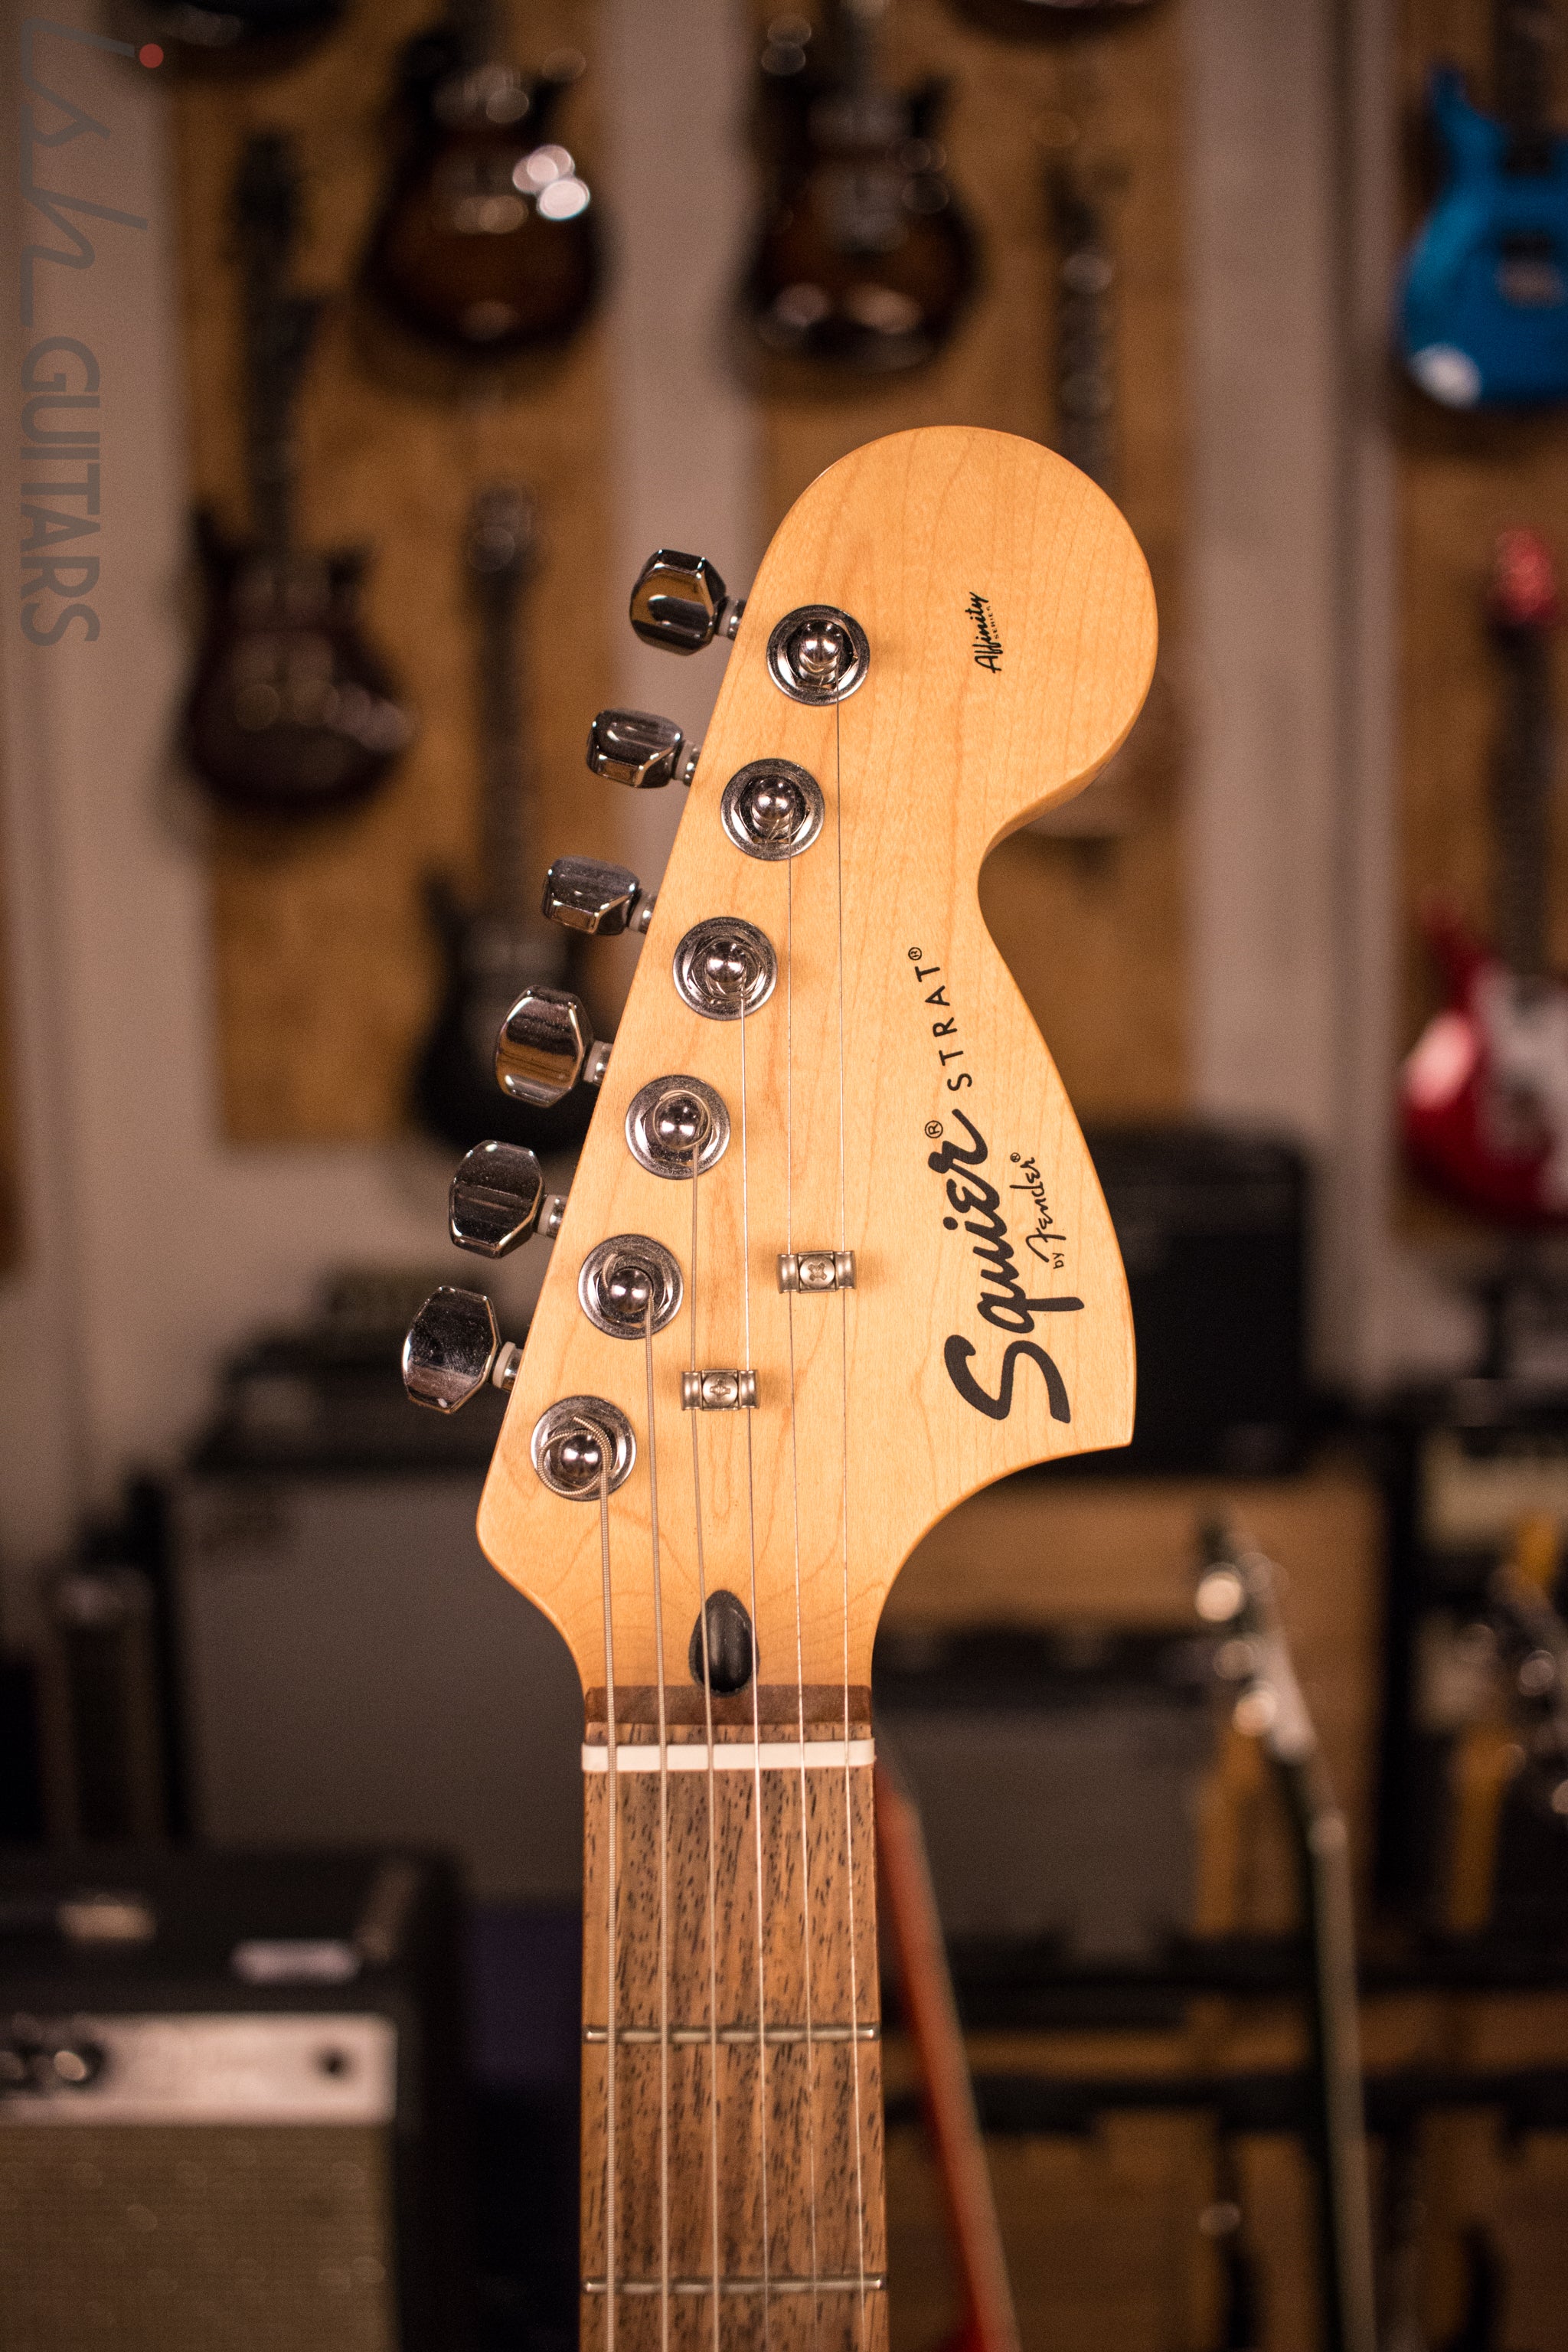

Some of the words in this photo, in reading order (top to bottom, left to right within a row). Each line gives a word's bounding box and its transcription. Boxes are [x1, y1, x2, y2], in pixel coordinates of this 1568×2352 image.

[964, 590, 1004, 674] Affinity
[985, 605, 1000, 640] SERIES
[1051, 1252, 1065, 1270] by
